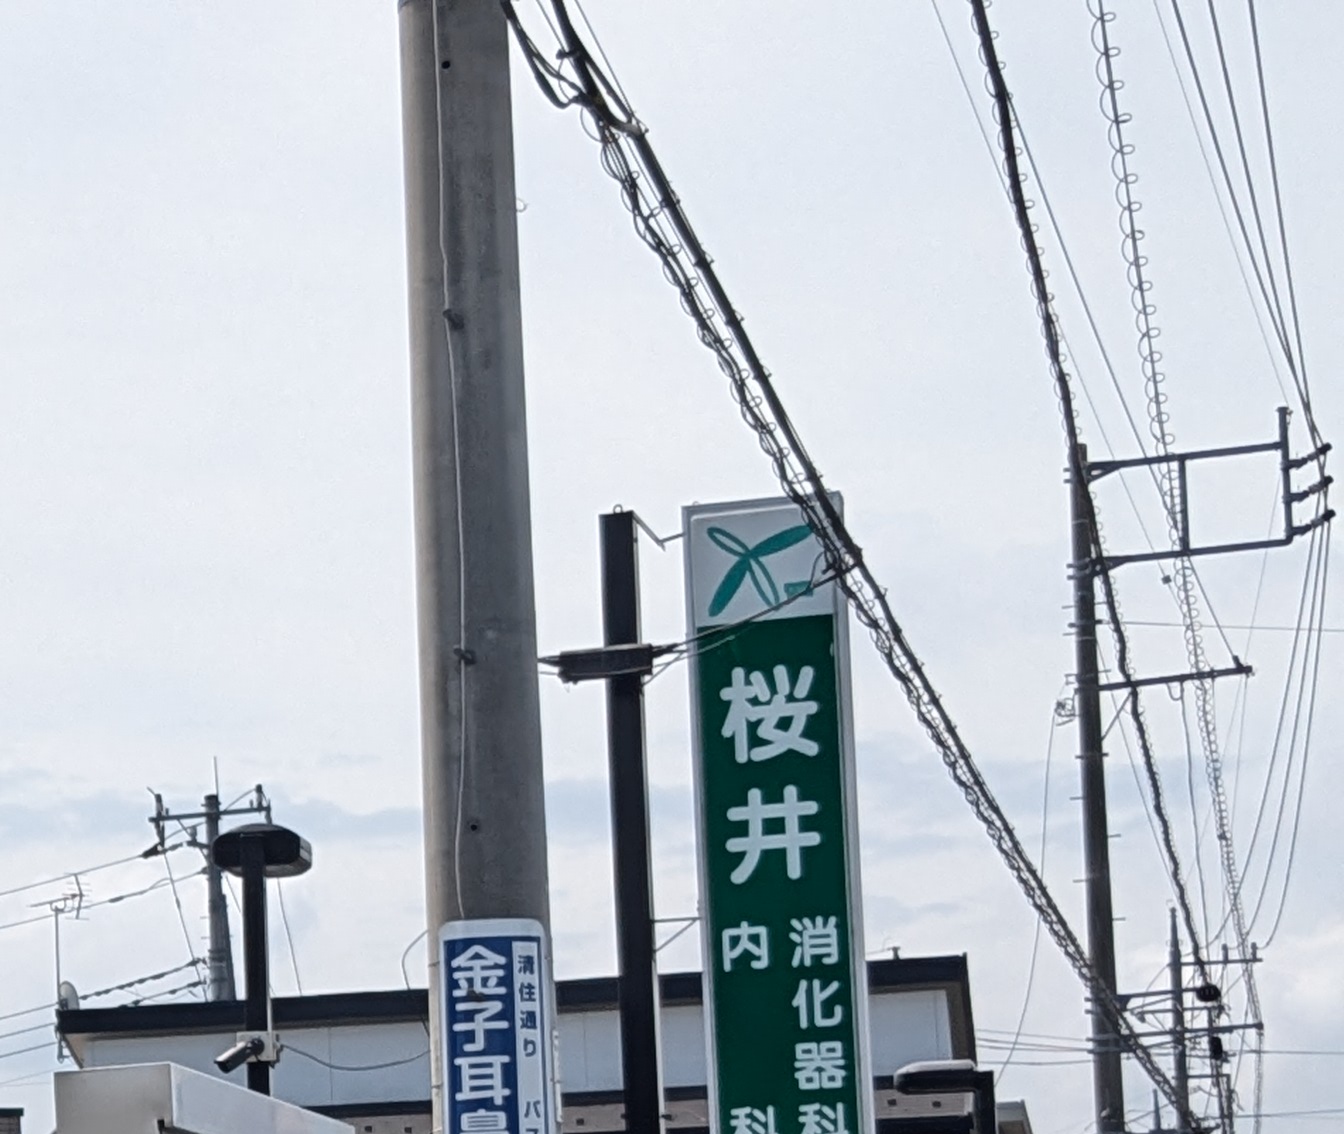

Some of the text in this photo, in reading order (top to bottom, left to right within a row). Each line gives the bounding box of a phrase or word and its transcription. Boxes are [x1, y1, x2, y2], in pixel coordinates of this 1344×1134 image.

[719, 664, 821, 885] 桜井
[517, 955, 538, 1058] 清住通り
